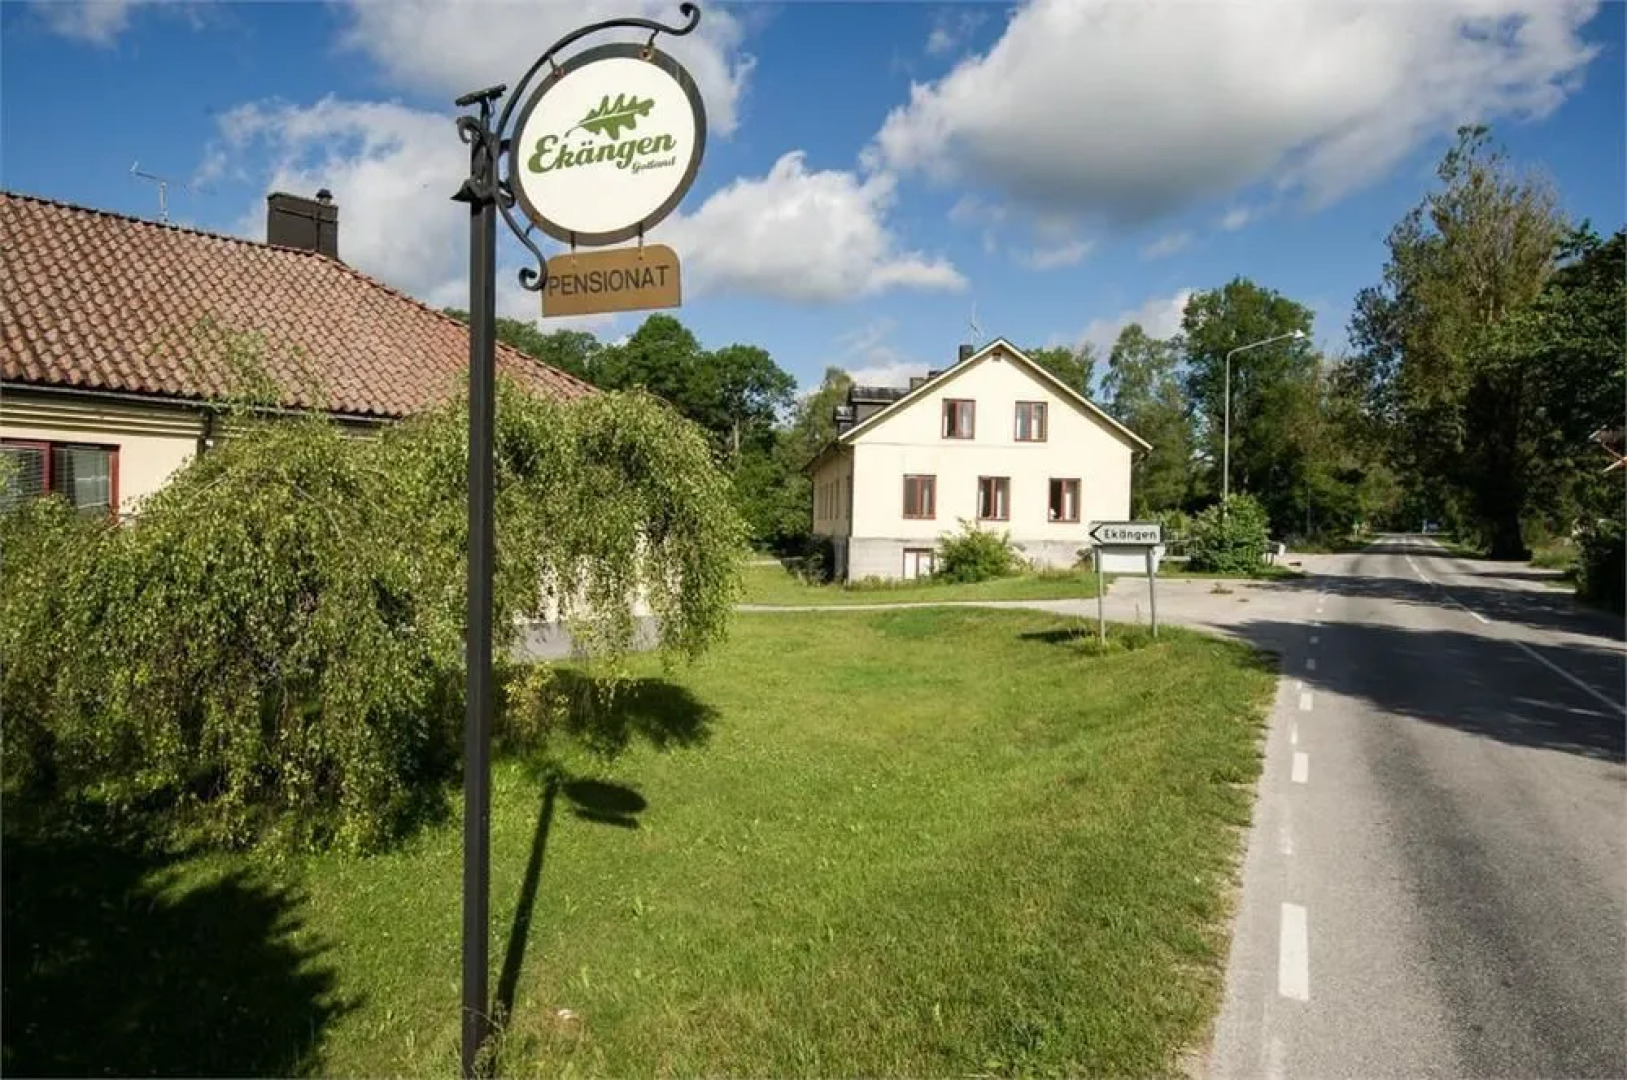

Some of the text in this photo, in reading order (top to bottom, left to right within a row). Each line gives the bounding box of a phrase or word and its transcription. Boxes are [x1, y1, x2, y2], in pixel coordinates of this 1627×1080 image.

[528, 133, 677, 174] Ekängen
[548, 265, 669, 297] PENSIONAT
[1104, 528, 1156, 540] Ekängen
